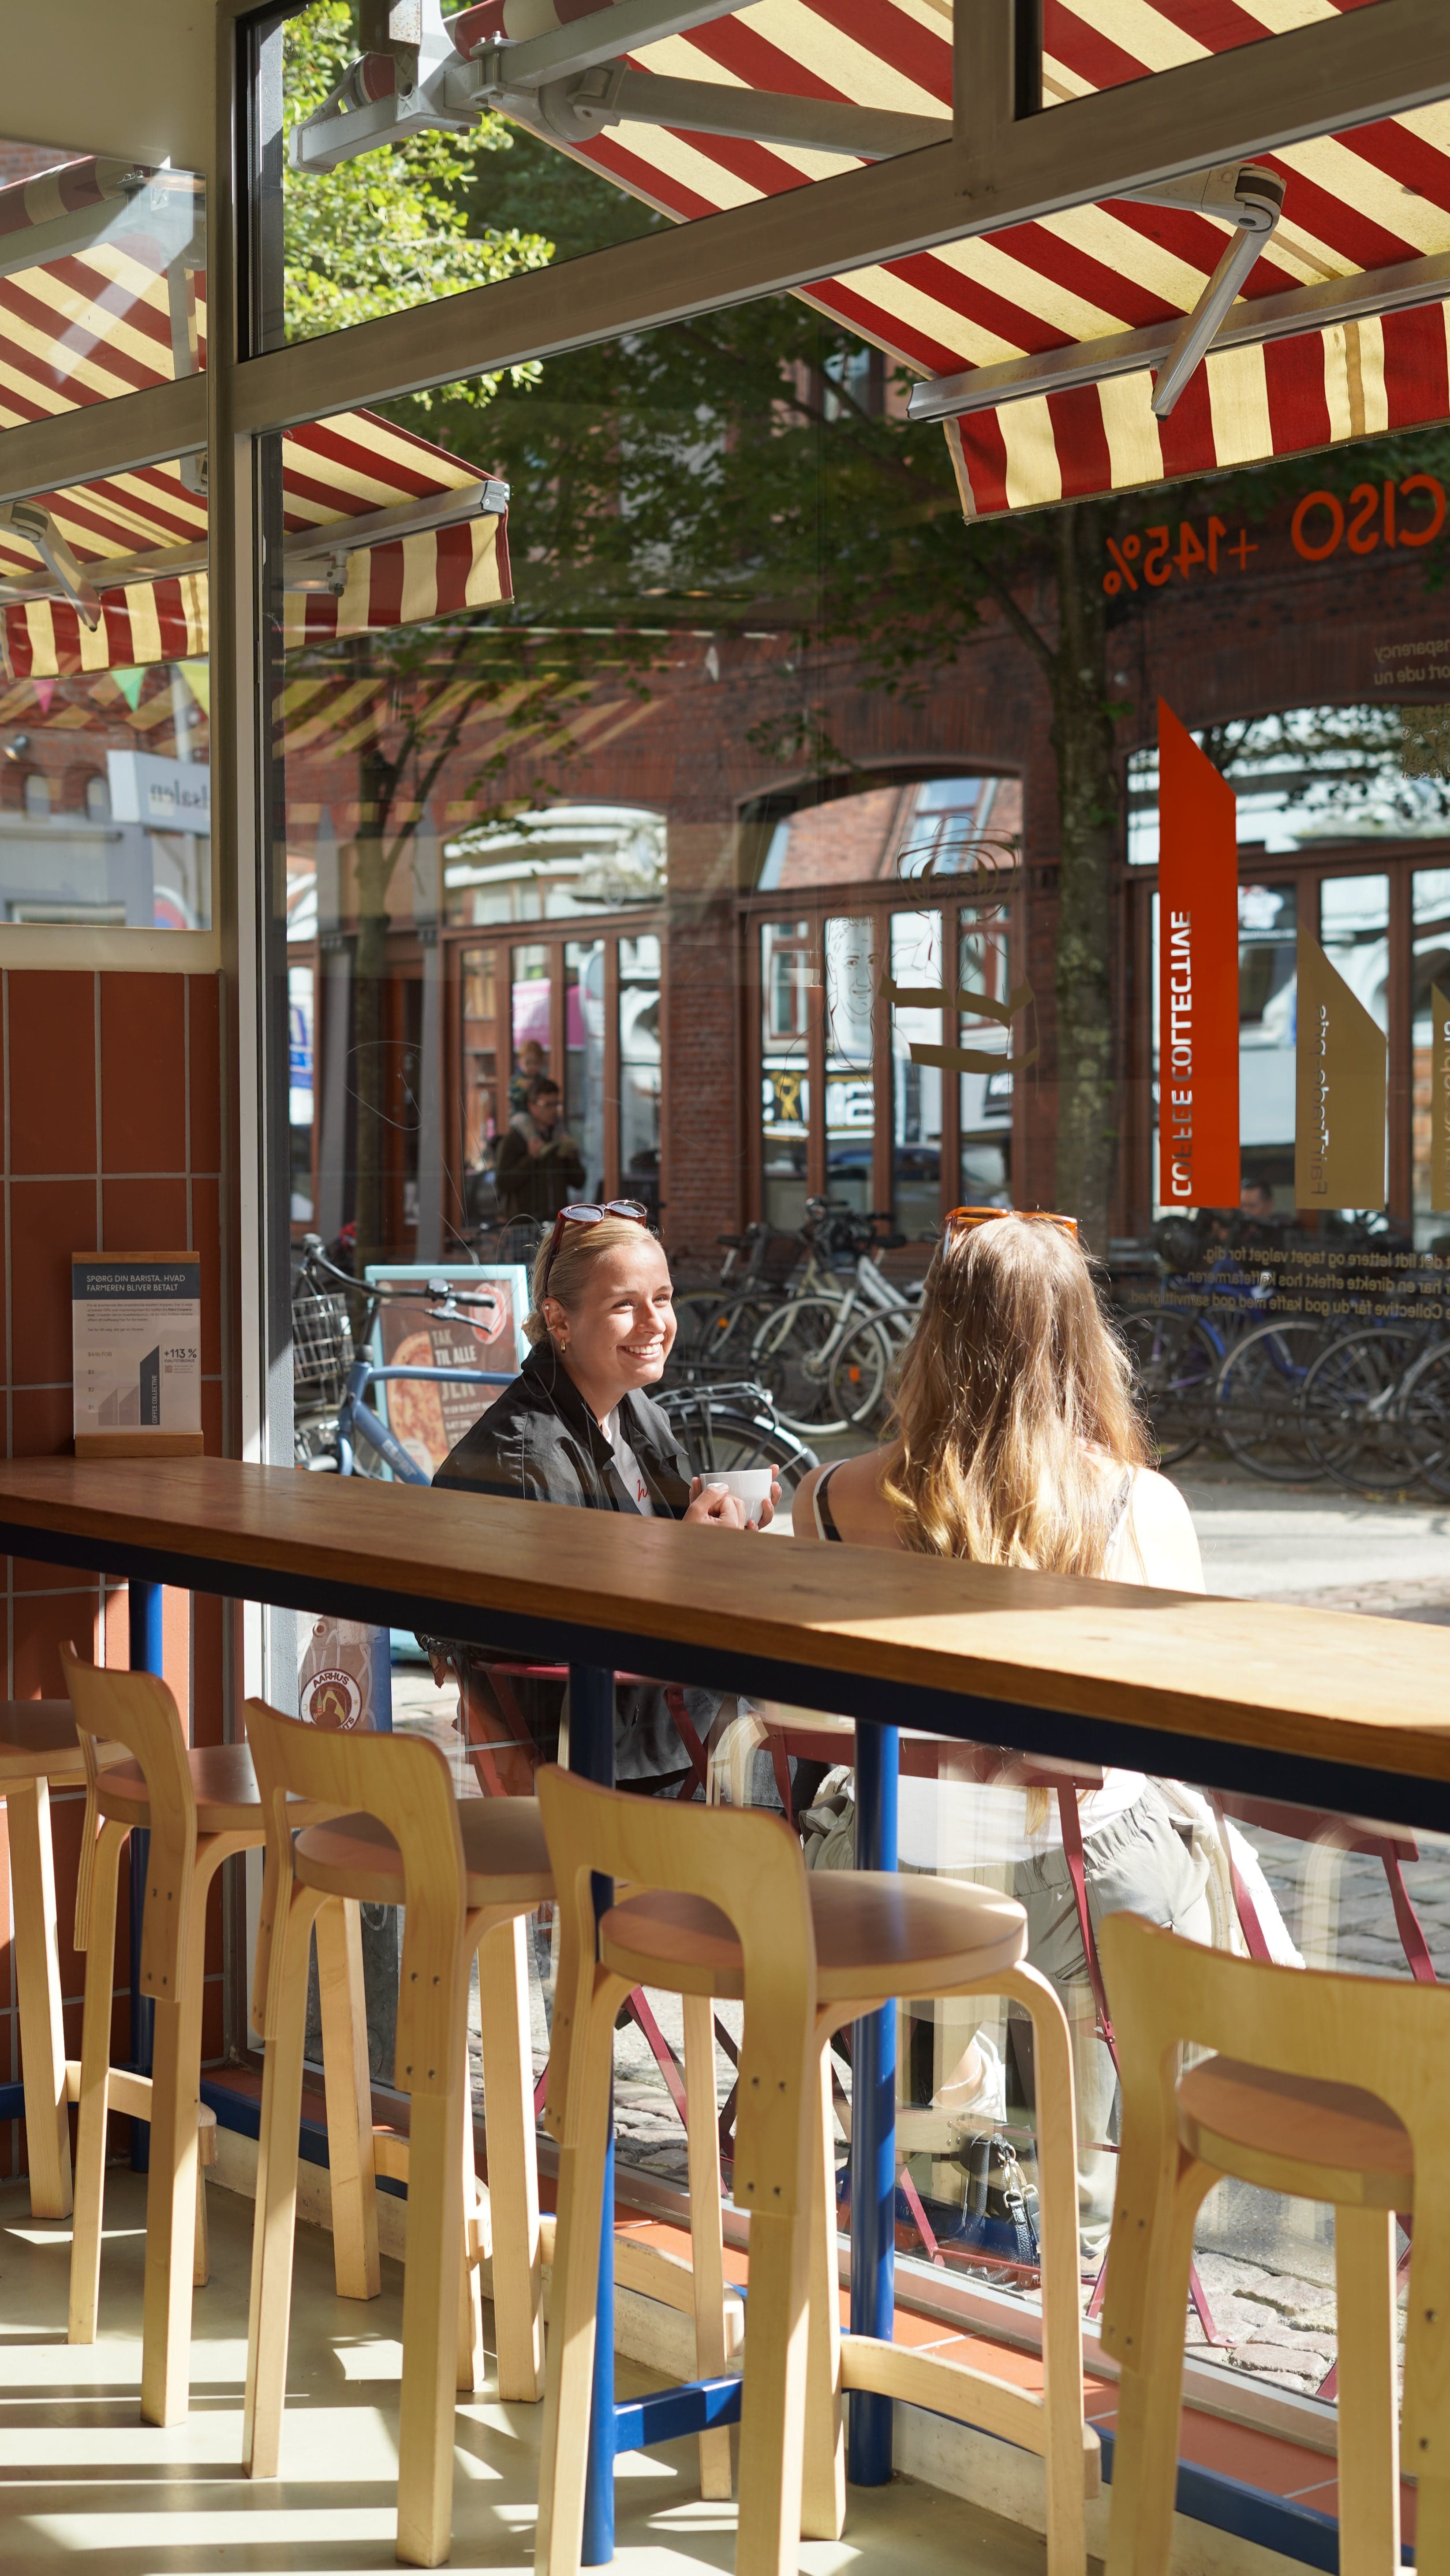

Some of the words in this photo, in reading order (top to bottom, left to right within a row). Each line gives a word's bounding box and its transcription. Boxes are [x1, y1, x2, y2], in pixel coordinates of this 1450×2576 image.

[164, 1349, 185, 1358] +113
[188, 1349, 197, 1358] %
[452, 1345, 477, 1364] ALLE
[313, 1672, 349, 1688] AARHUS
